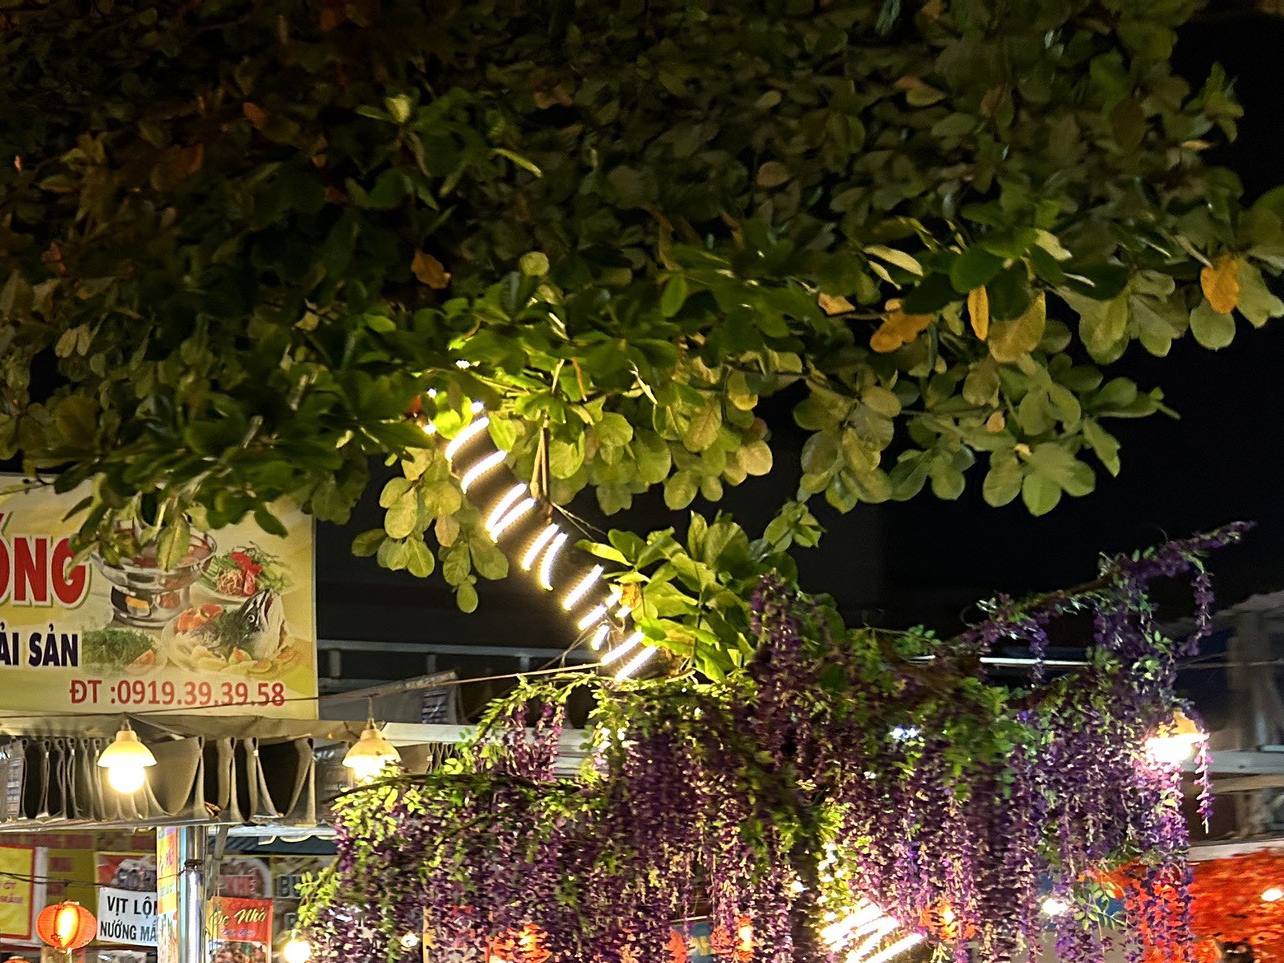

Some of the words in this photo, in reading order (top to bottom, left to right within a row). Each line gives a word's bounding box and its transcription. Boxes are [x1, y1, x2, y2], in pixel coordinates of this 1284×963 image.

[28, 623, 79, 668] SẢN
[69, 679, 103, 704] ĐT
[107, 895, 128, 916] VỊT
[100, 919, 137, 941] NƯỚNG
